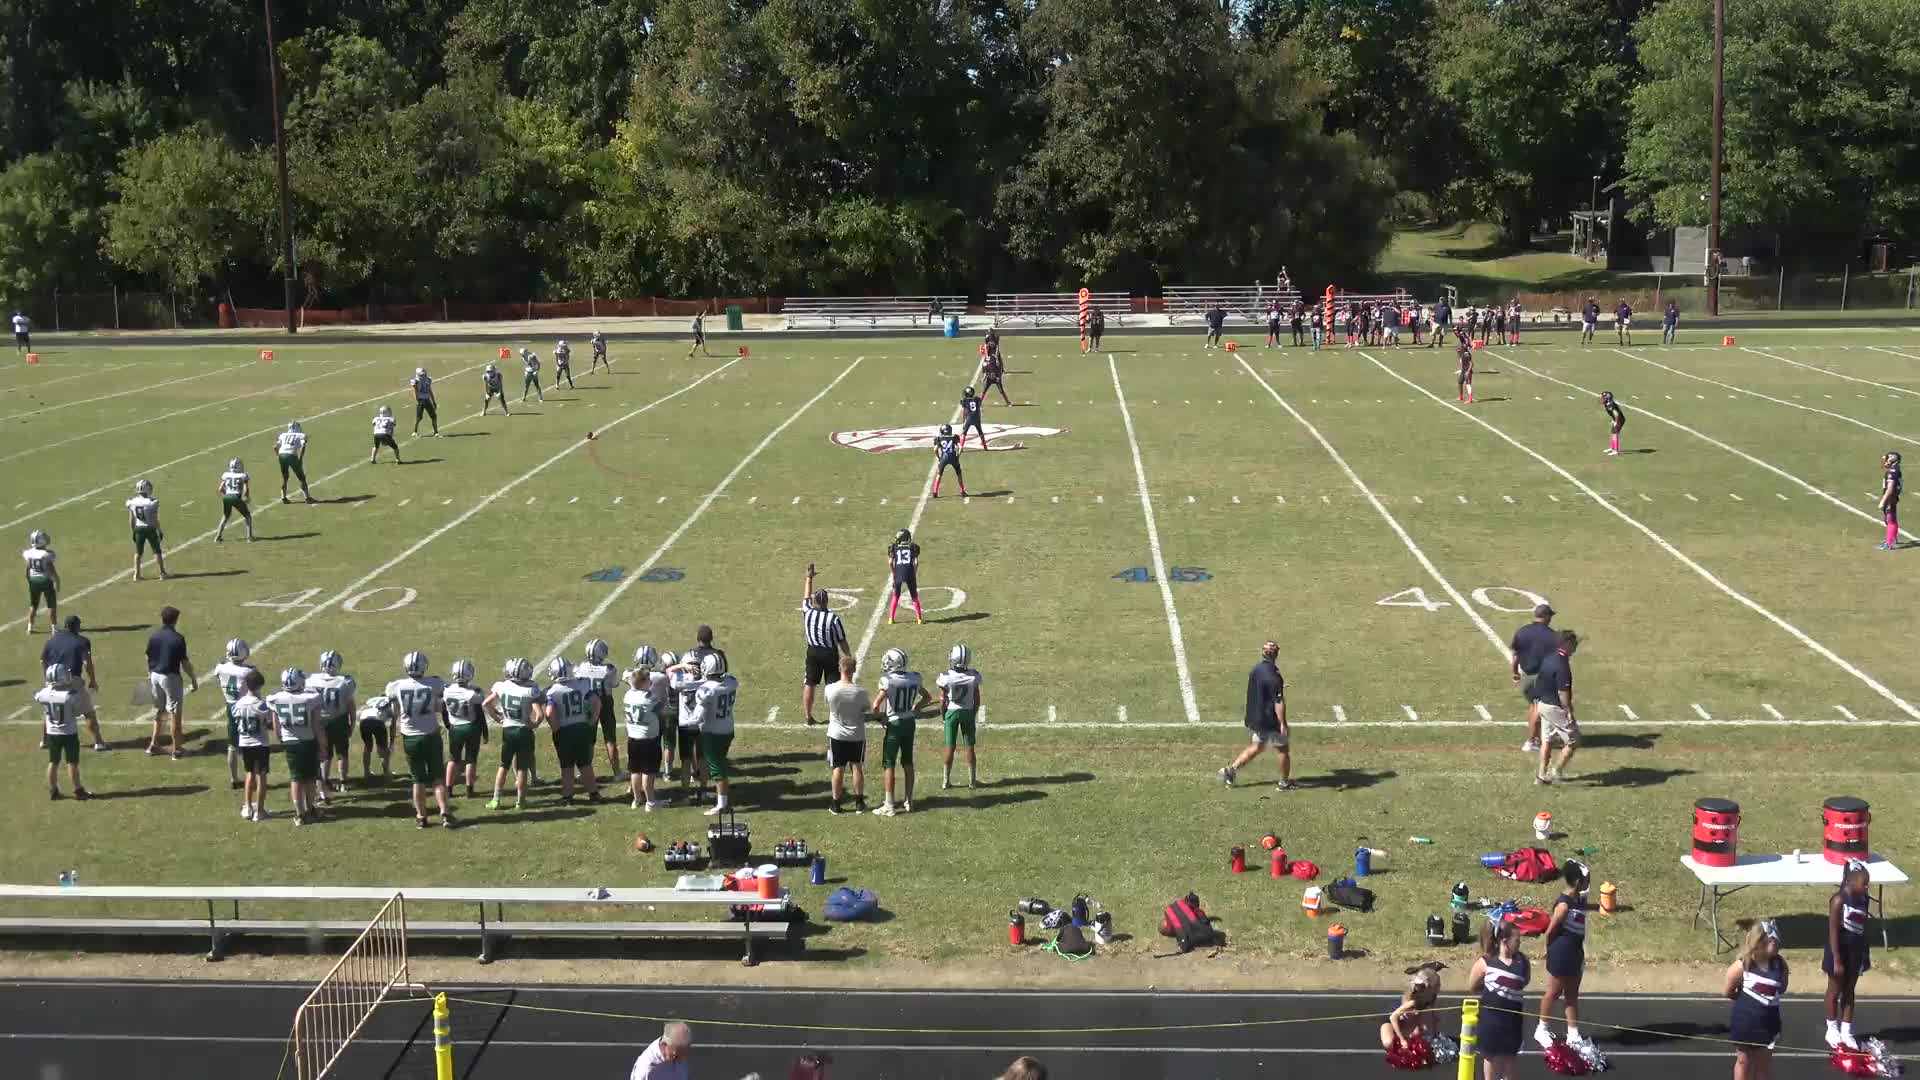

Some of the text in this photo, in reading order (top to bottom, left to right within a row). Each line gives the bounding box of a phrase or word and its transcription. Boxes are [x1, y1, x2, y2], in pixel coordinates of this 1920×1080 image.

[896, 549, 911, 564] 13
[240, 587, 417, 613] 40
[1375, 587, 1550, 612] 40
[226, 675, 240, 698] 4
[401, 689, 431, 715] 72
[563, 690, 582, 716] 19
